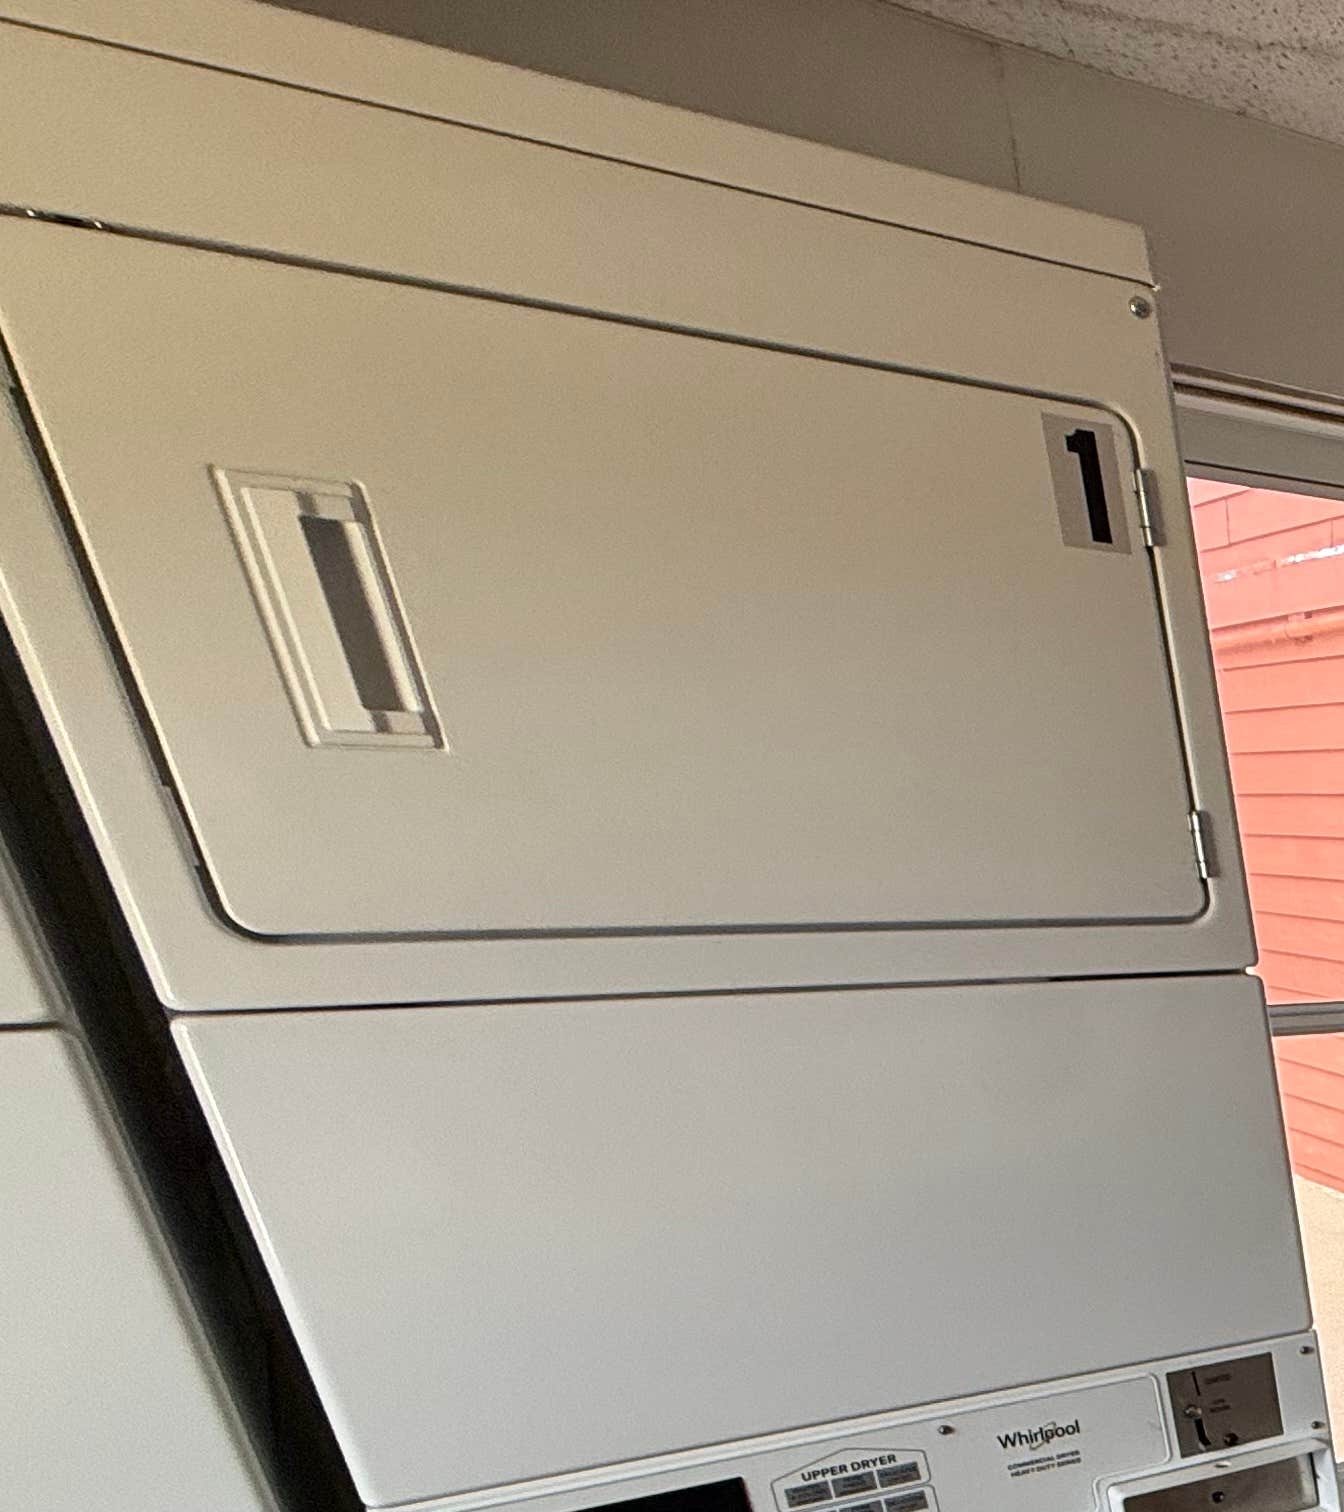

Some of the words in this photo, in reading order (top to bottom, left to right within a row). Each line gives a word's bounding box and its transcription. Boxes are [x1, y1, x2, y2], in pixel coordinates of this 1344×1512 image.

[1064, 428, 1113, 545] 1
[996, 1418, 1081, 1448] Whirlpool
[801, 1464, 848, 1482] UPPER
[851, 1454, 898, 1472] DRYER
